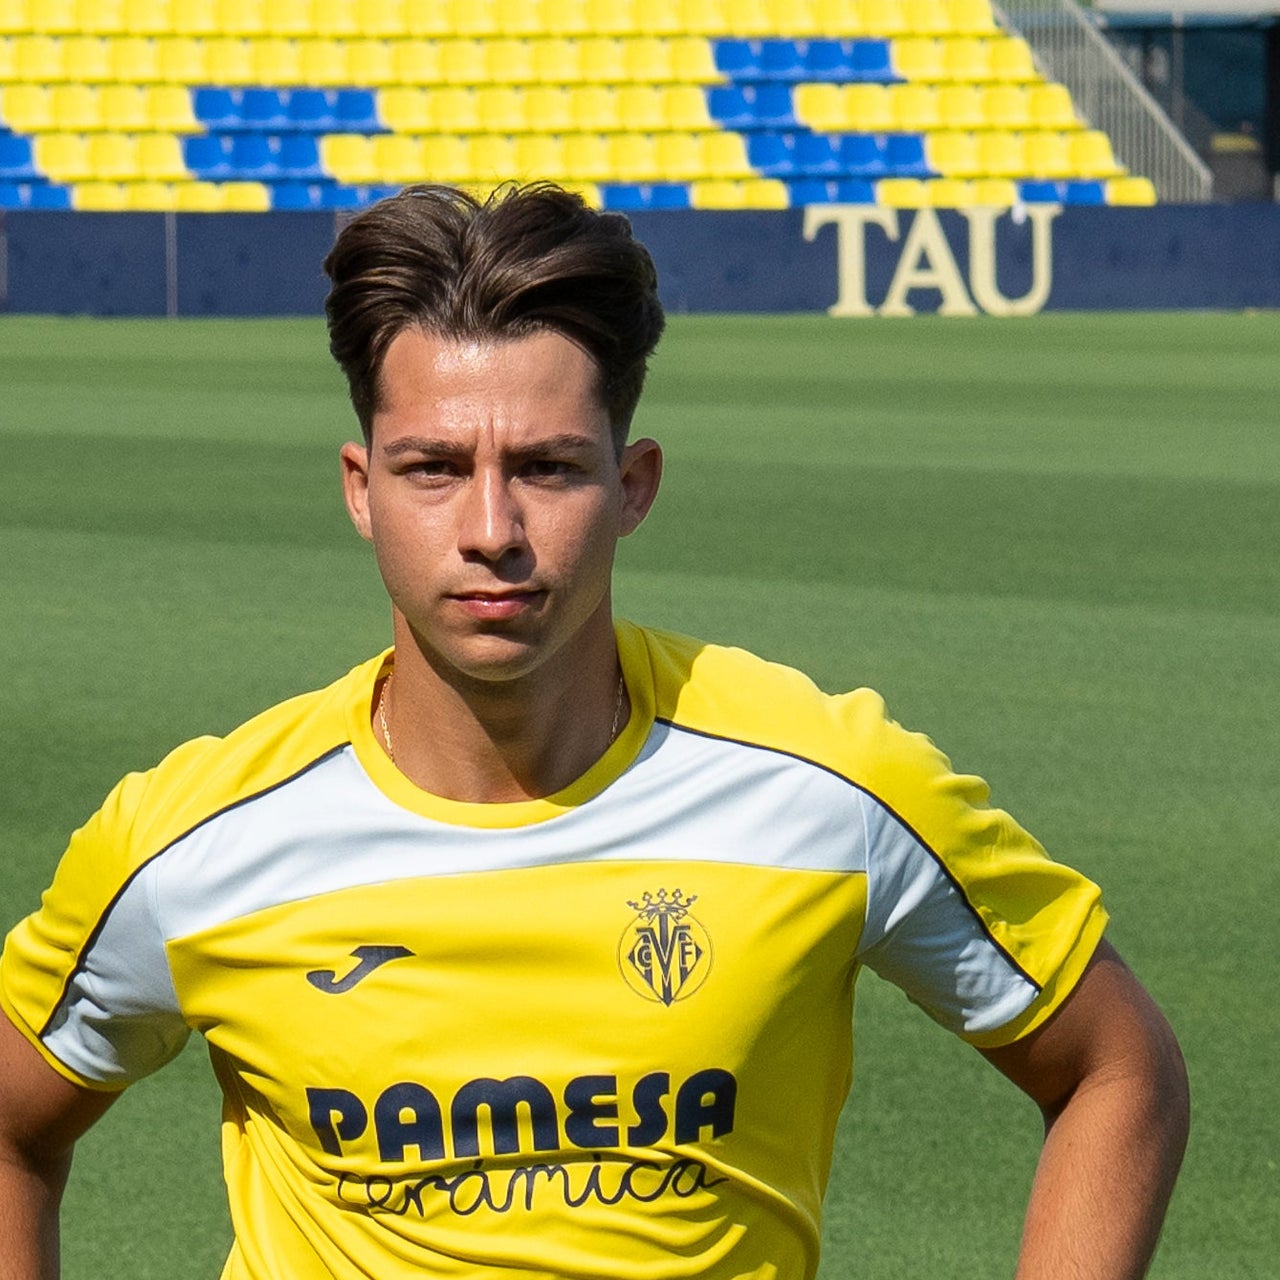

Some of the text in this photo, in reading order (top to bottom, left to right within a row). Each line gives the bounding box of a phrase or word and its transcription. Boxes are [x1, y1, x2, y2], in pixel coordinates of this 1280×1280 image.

[802, 205, 1062, 317] TAU
[305, 1069, 738, 1162] PAMESA
[338, 1156, 729, 1217] cerámica
